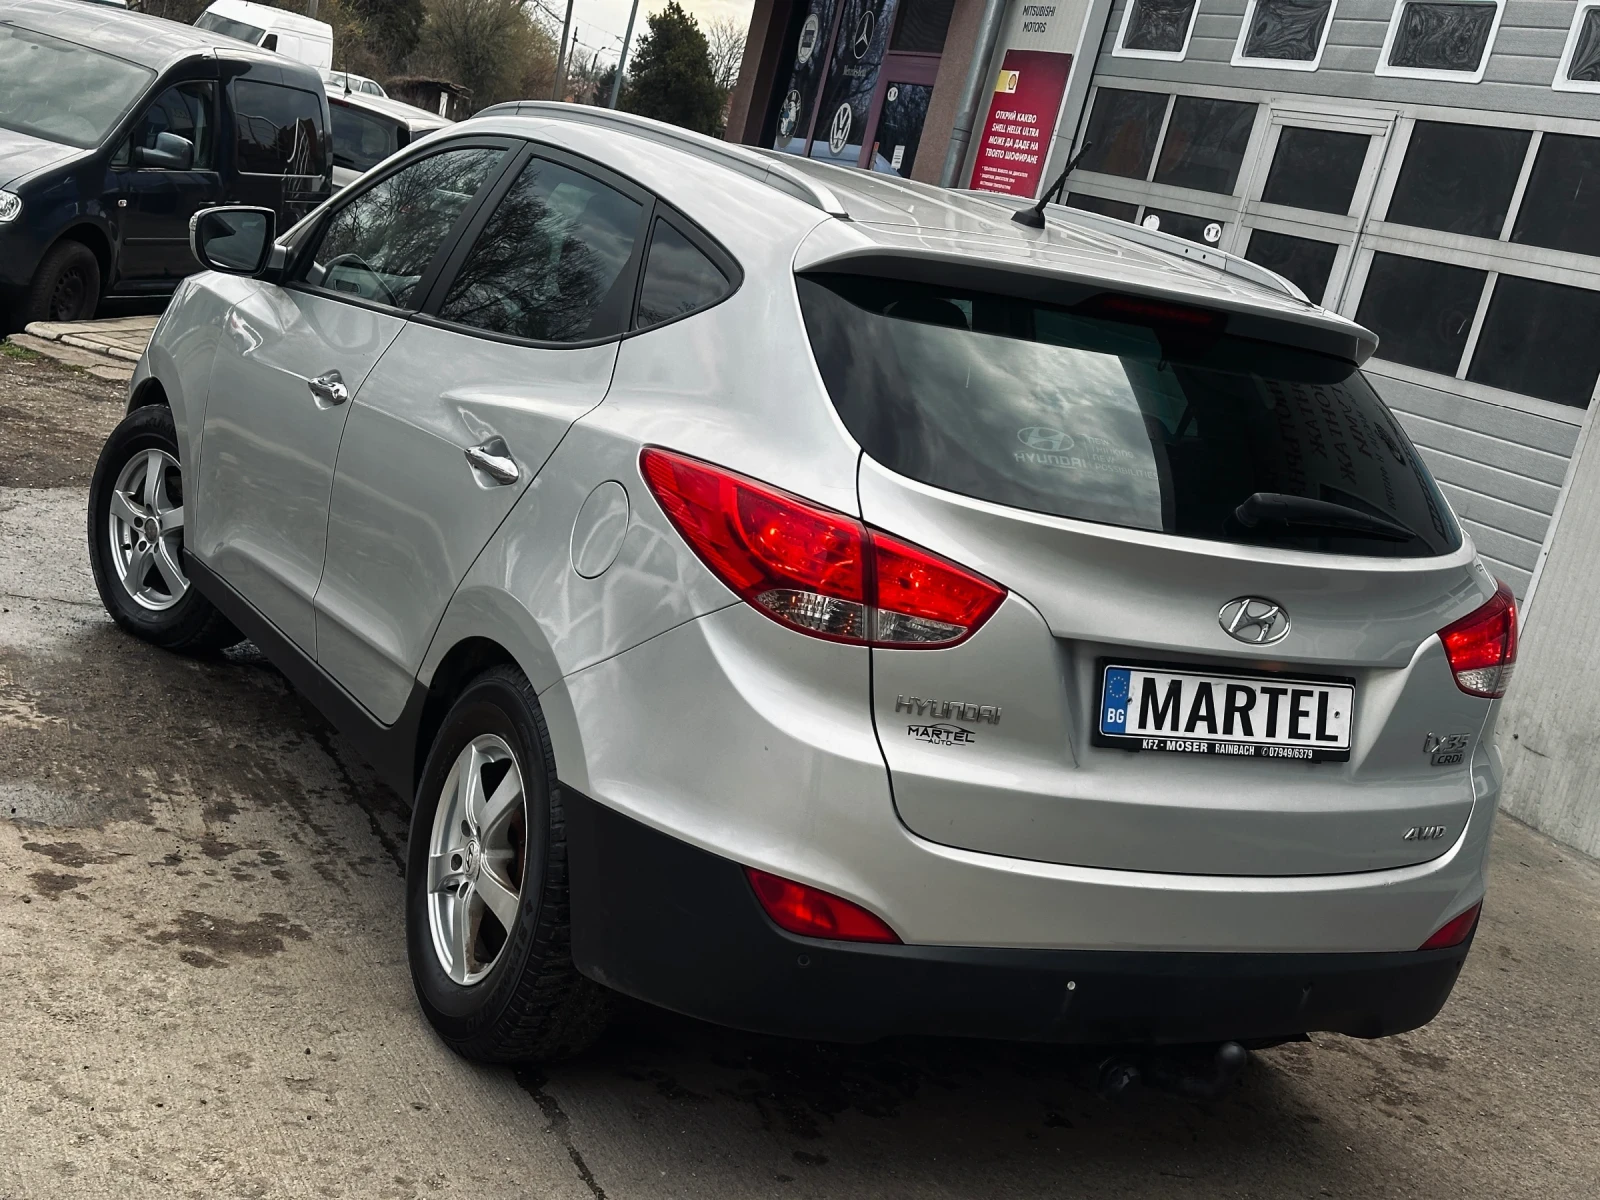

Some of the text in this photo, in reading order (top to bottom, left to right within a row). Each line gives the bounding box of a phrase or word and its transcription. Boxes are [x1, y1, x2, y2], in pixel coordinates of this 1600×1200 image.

[1022, 5, 1056, 17] MITSUBISHI
[1022, 21, 1047, 33] MOTORS
[995, 110, 1037, 124] ОТКРИЙ КАКВО
[991, 122, 1040, 138] SHELL HELIX ULTRA
[988, 135, 1039, 151] МОЖЕ ДА ДАДЕ НА
[985, 148, 1038, 164] ТВОЕТО ШОФИРАНЕ
[1014, 452, 1087, 468] HYUNDAI
[895, 694, 1002, 725] HYUNDAI
[1106, 708, 1125, 724] BG
[1137, 676, 1339, 743] MARTEL
[907, 726, 975, 743] MARTEL
[1142, 738, 1158, 750] KFZ
[1166, 740, 1208, 753] MOSER
[1215, 743, 1255, 756] RAINBACH
[1268, 747, 1313, 759] 07949/6379
[1437, 754, 1463, 764] CRDi
